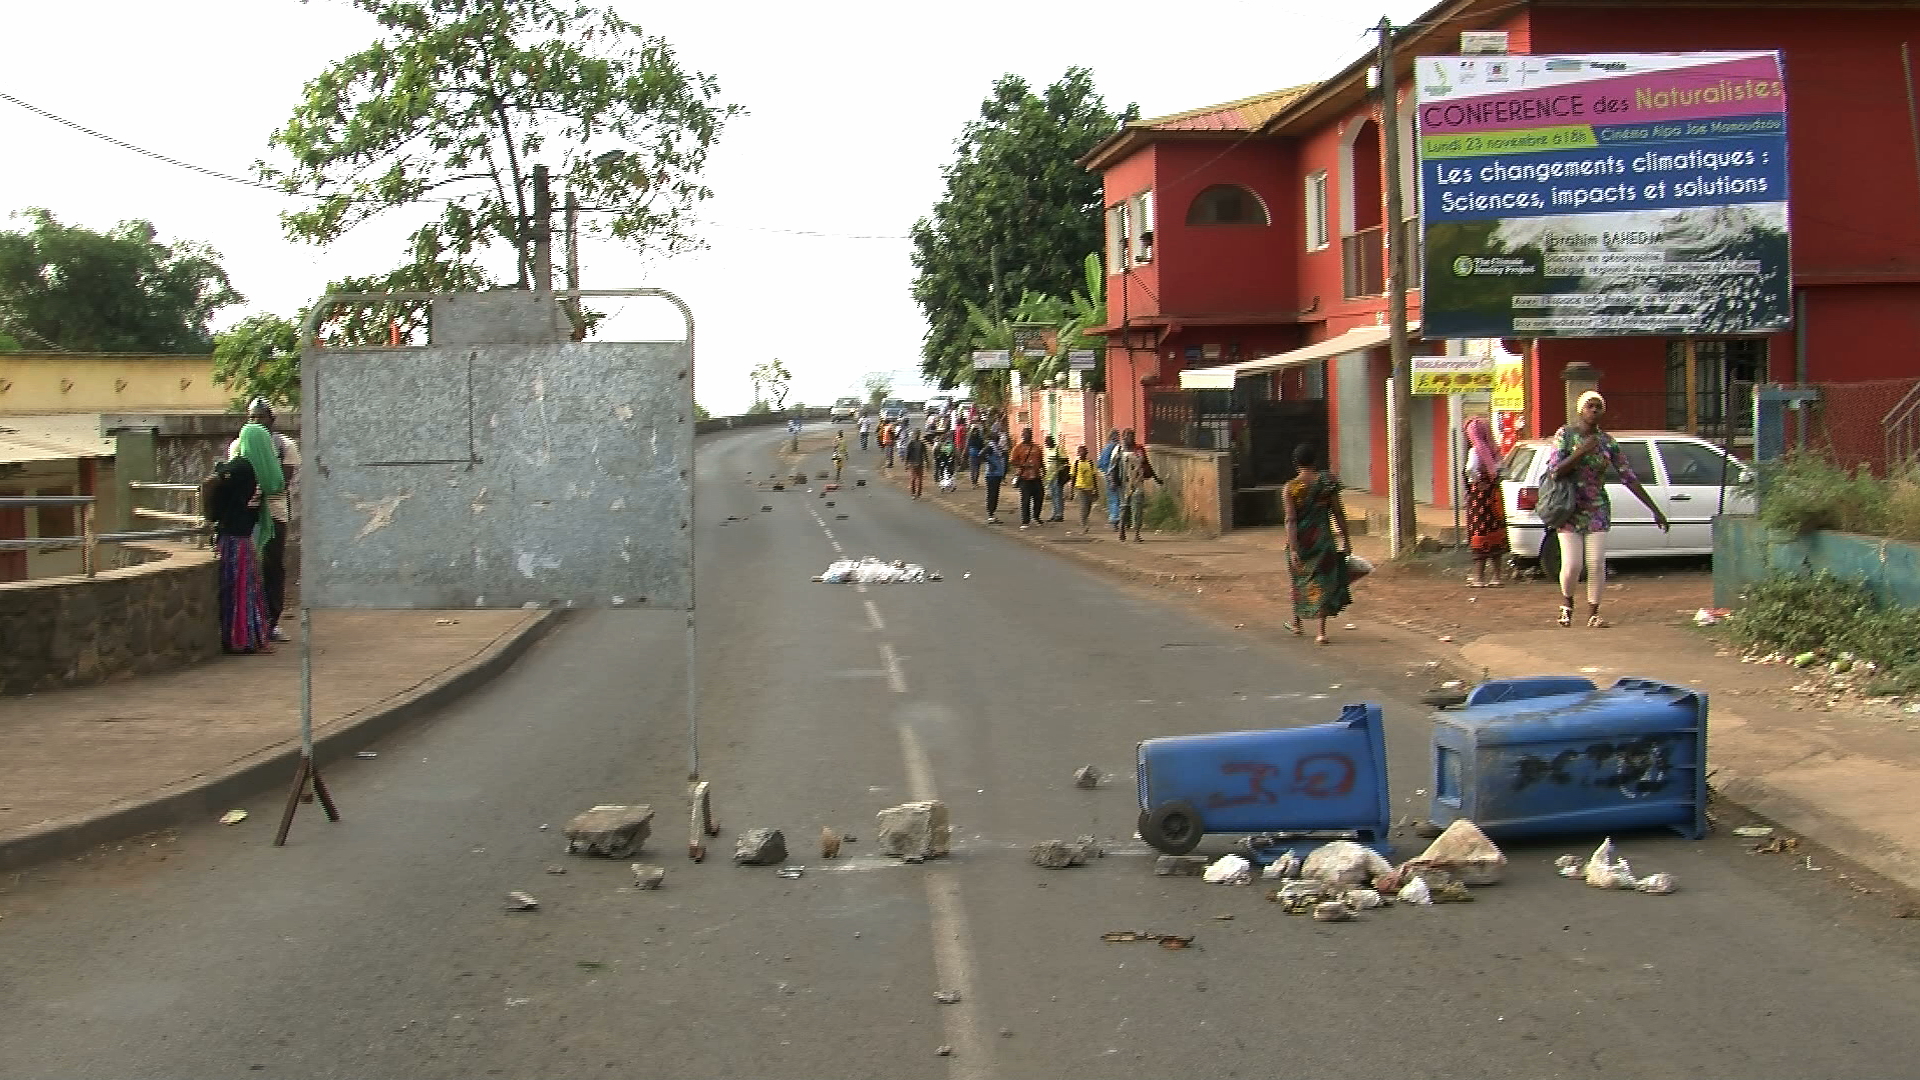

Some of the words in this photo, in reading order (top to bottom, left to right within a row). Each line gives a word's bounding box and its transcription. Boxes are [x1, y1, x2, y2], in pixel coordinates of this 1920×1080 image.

[1424, 95, 1585, 128] CONFERENCE
[1593, 96, 1630, 114] des
[1635, 79, 1782, 111] Naturalistes
[1427, 137, 1461, 154] Lundi
[1466, 136, 1484, 151] 23
[1488, 133, 1549, 149] novembre
[1601, 127, 1650, 142] Cinéma
[1686, 122, 1709, 136] Joe
[1711, 117, 1782, 133] Mamoudzou
[1436, 163, 1473, 186] Les
[1479, 155, 1626, 183] changements
[1632, 149, 1754, 175] climatiques
[1441, 190, 1545, 213] Sciences,
[1551, 182, 1636, 209] impacts
[1643, 181, 1667, 199] et
[1673, 176, 1768, 197] solutions
[1547, 232, 1599, 246] Ibrahim
[1603, 230, 1665, 246] BAHEDJA
